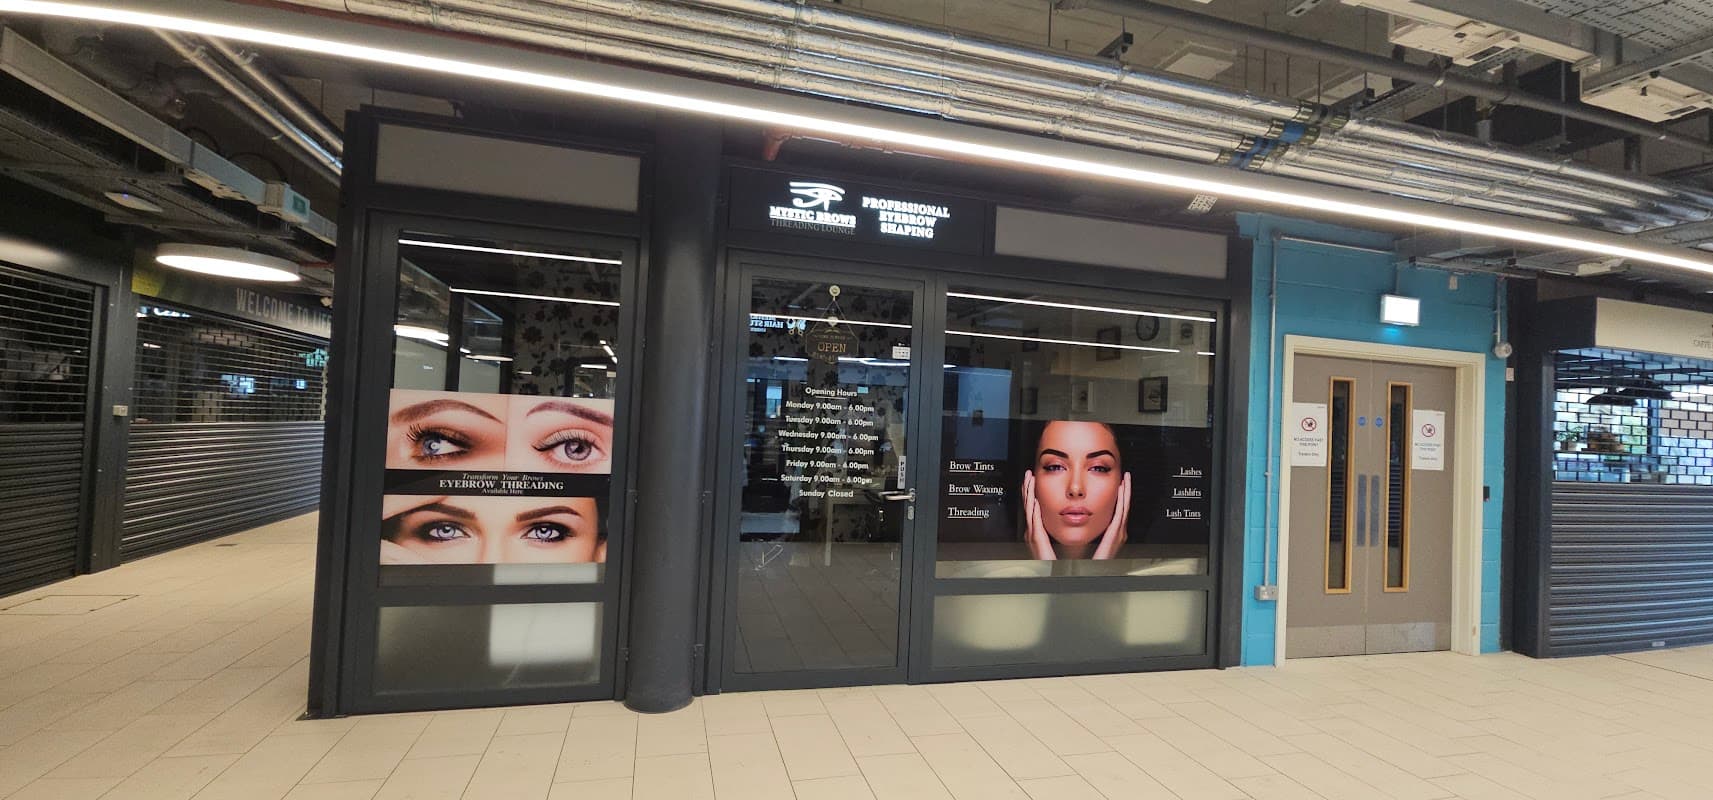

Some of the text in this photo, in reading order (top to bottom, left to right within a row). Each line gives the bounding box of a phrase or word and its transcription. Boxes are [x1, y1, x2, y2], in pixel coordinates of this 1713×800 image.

[862, 196, 951, 219] PROFESSIONAL
[769, 206, 857, 226] MYSTIC BROWS
[879, 210, 937, 228] EYEBROW
[771, 218, 856, 236] THREADING LOUNGE
[880, 222, 934, 239] SHAPING
[236, 287, 293, 323] WELCOME
[297, 306, 309, 328] TO
[817, 342, 846, 353] OPEN
[805, 387, 857, 397] Opening Hours
[785, 401, 814, 410] Monday
[815, 402, 842, 410] 9.00am
[848, 404, 875, 413] 6.00pm
[785, 415, 813, 425] Tuesday
[815, 417, 842, 425] 9.00am
[847, 418, 874, 427] 6.00pm
[778, 430, 819, 439] Wednesday
[820, 432, 846, 440] 9.00am
[852, 433, 879, 442] 6.00pm
[781, 444, 814, 454] Thursday
[815, 446, 842, 454] 9.00am
[848, 447, 875, 456] 6.00pm
[785, 460, 808, 469] Friday
[809, 460, 836, 468] 9.00am
[842, 462, 869, 470] 6.00pm
[950, 461, 995, 471] Brow Tints
[1180, 466, 1202, 476] Lashes
[462, 472, 499, 480] Transform
[502, 473, 519, 481] Your
[780, 474, 812, 483] Saturday
[813, 475, 840, 483] 9.00am
[846, 476, 873, 485] 6.00pm
[440, 480, 564, 490] EYEBROW THREADING
[949, 484, 1004, 496] Brow Waxing
[799, 489, 854, 498] Sunday Closed
[948, 506, 990, 519] Threading
[1166, 508, 1182, 518] Lash
